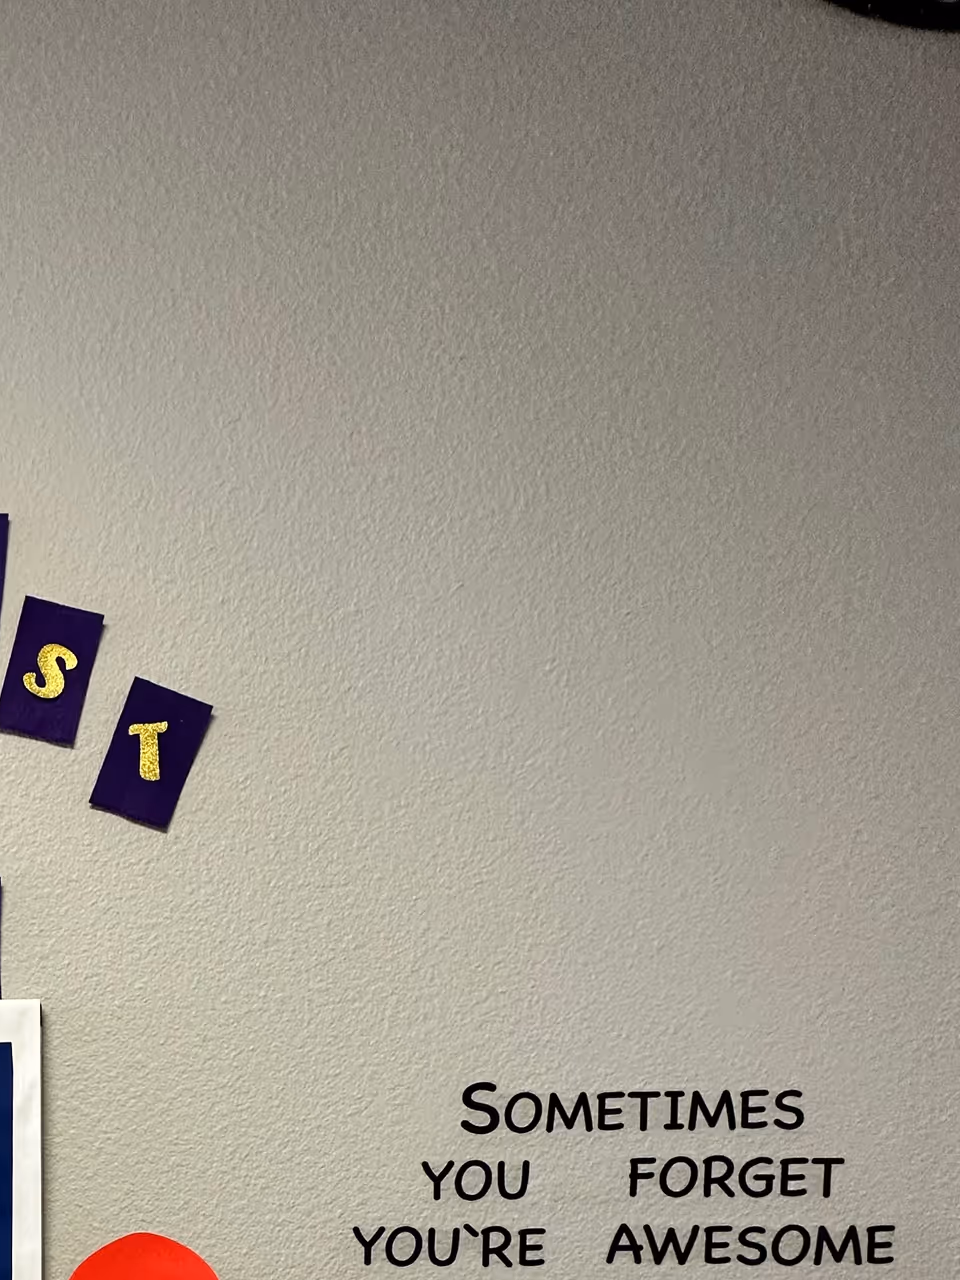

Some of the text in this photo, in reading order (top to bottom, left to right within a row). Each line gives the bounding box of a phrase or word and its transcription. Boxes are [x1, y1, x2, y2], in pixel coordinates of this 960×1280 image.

[460, 1081, 806, 1134] SOMETIMES
[421, 1156, 845, 1201] YOU FORGET
[606, 1224, 896, 1267] AWESOME
